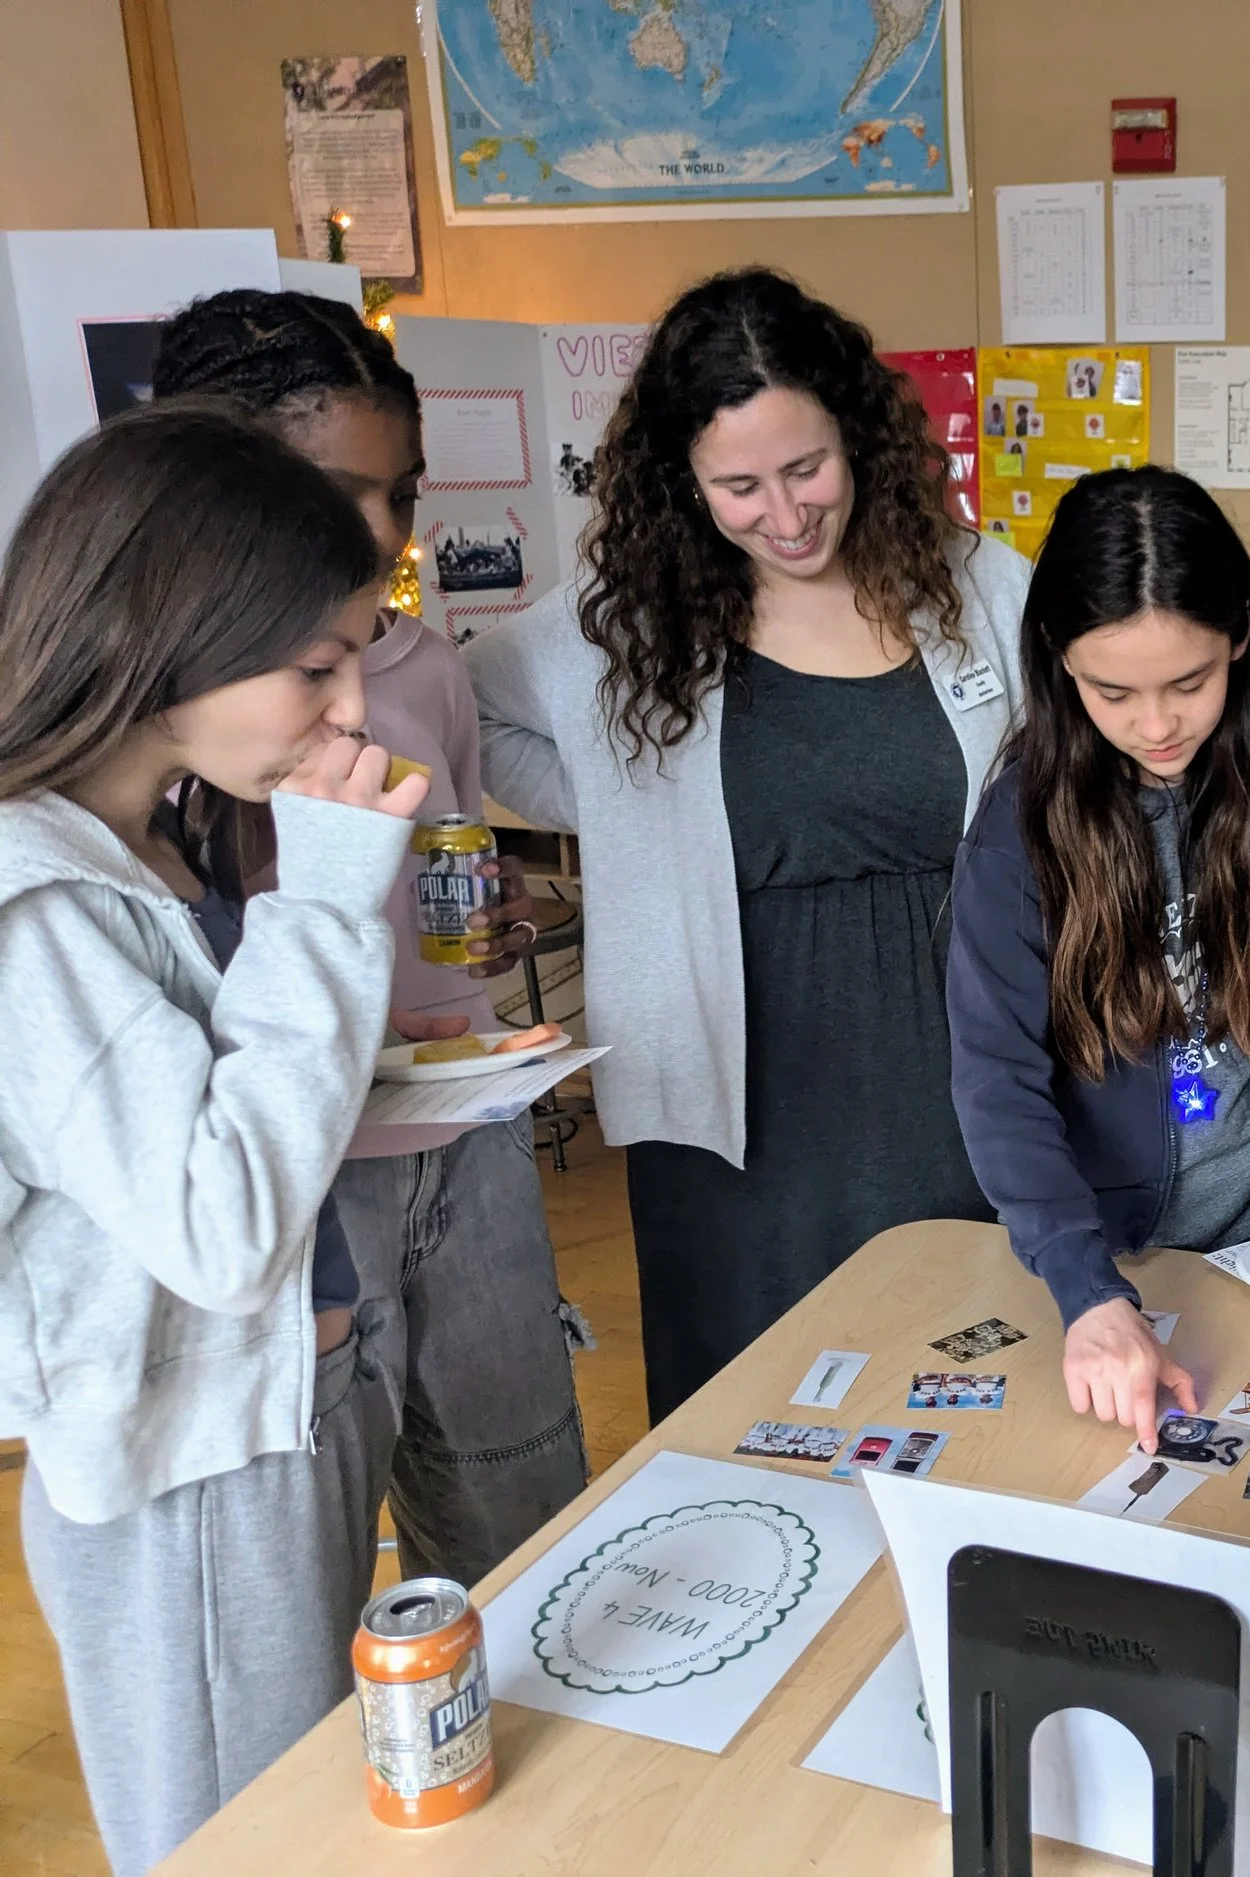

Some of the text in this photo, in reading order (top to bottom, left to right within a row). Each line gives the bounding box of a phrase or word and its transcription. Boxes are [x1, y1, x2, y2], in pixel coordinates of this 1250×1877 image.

[658, 164, 681, 176] THE
[684, 162, 725, 175] WORLD
[420, 875, 470, 901] POLAR
[614, 1561, 672, 1587] Now
[688, 1579, 766, 1608] 2000
[603, 1600, 710, 1639] WAVE 4
